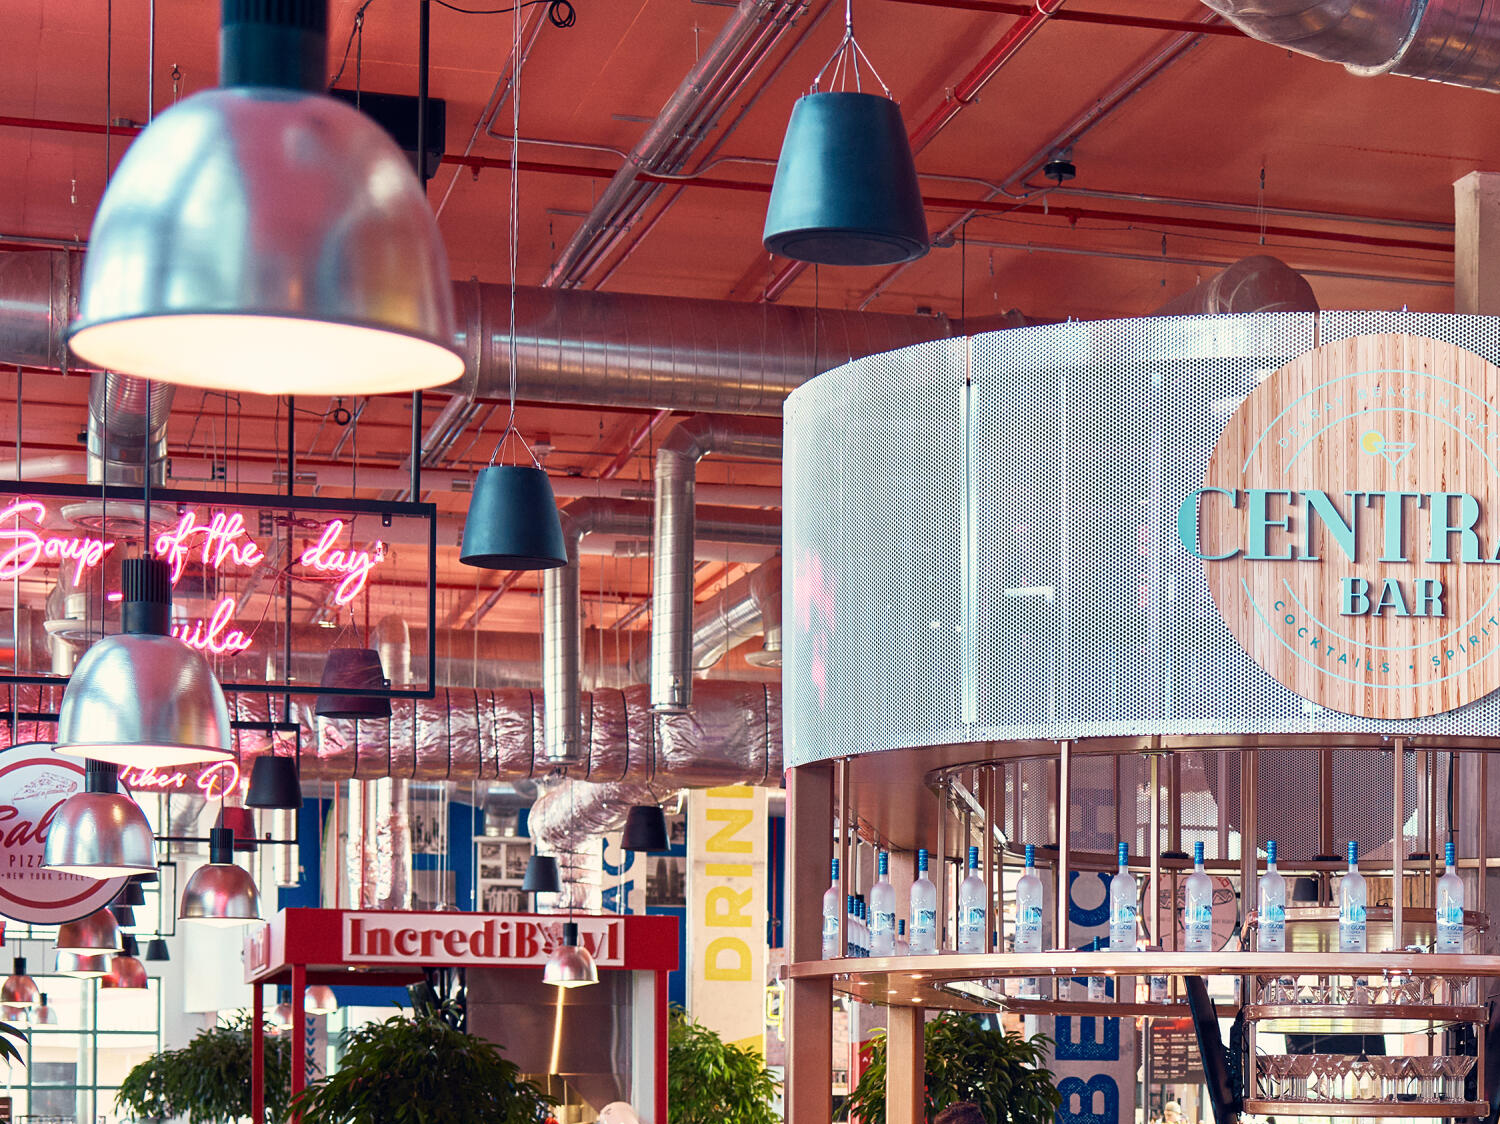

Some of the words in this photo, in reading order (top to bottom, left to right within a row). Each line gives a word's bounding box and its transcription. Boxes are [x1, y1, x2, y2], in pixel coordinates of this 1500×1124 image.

[1278, 395, 1344, 449] DELRAY
[1357, 386, 1426, 401] BEACH
[0, 500, 114, 588] Soup
[154, 511, 199, 583] of
[192, 512, 265, 568] the
[1339, 576, 1446, 618] BAR
[1274, 600, 1391, 674] COCKTAILS
[9, 854, 44, 868] PIZZ
